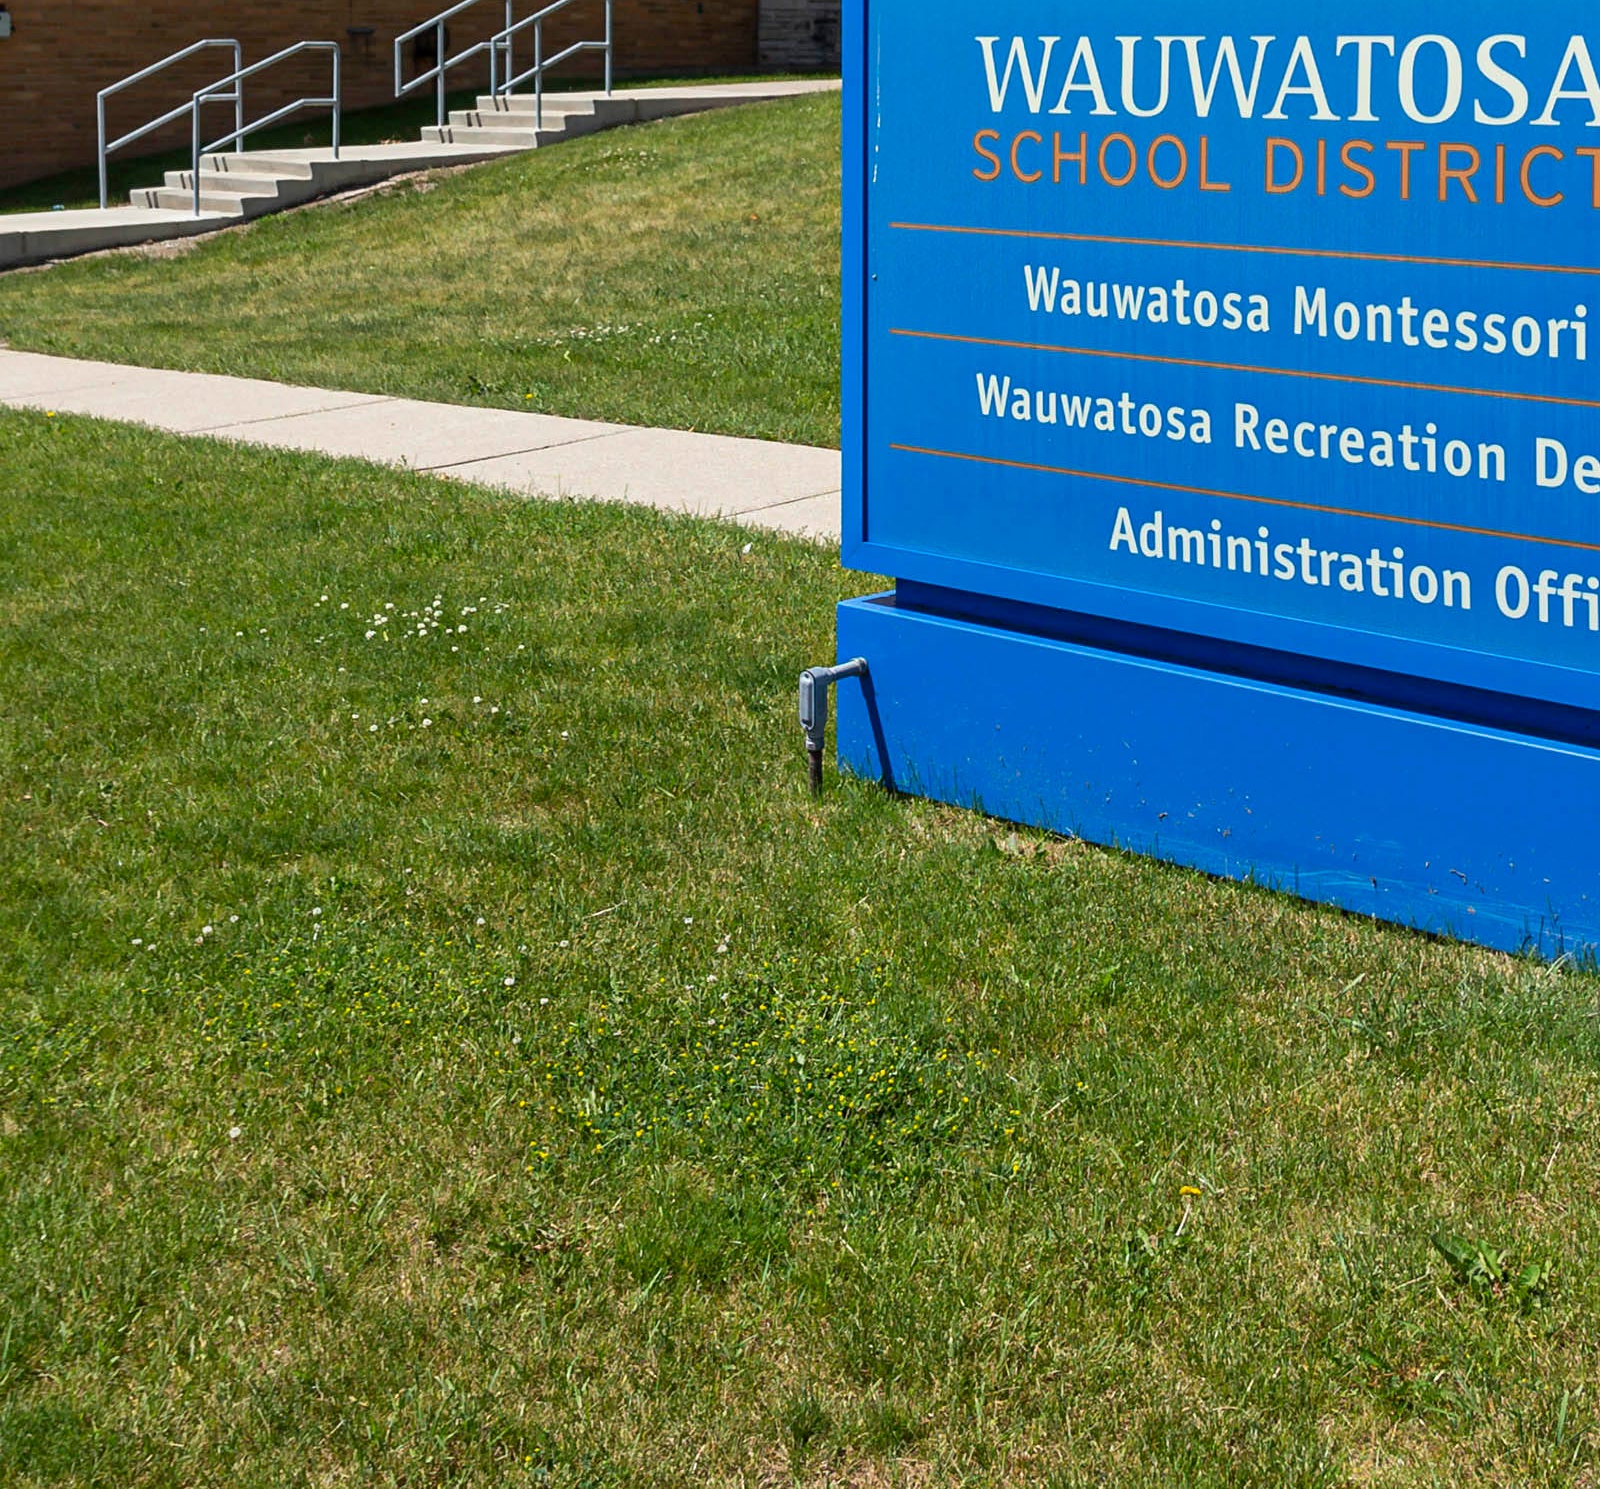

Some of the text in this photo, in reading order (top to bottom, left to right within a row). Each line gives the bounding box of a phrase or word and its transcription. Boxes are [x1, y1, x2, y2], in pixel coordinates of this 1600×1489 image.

[973, 129, 1231, 191] SCHOOL
[1023, 264, 1270, 333] Wauwatosa
[1294, 285, 1587, 361] Montessori
[975, 372, 1212, 444] Wauwatosa
[1234, 403, 1505, 482] Recreation
[1109, 506, 1471, 610] Administration
